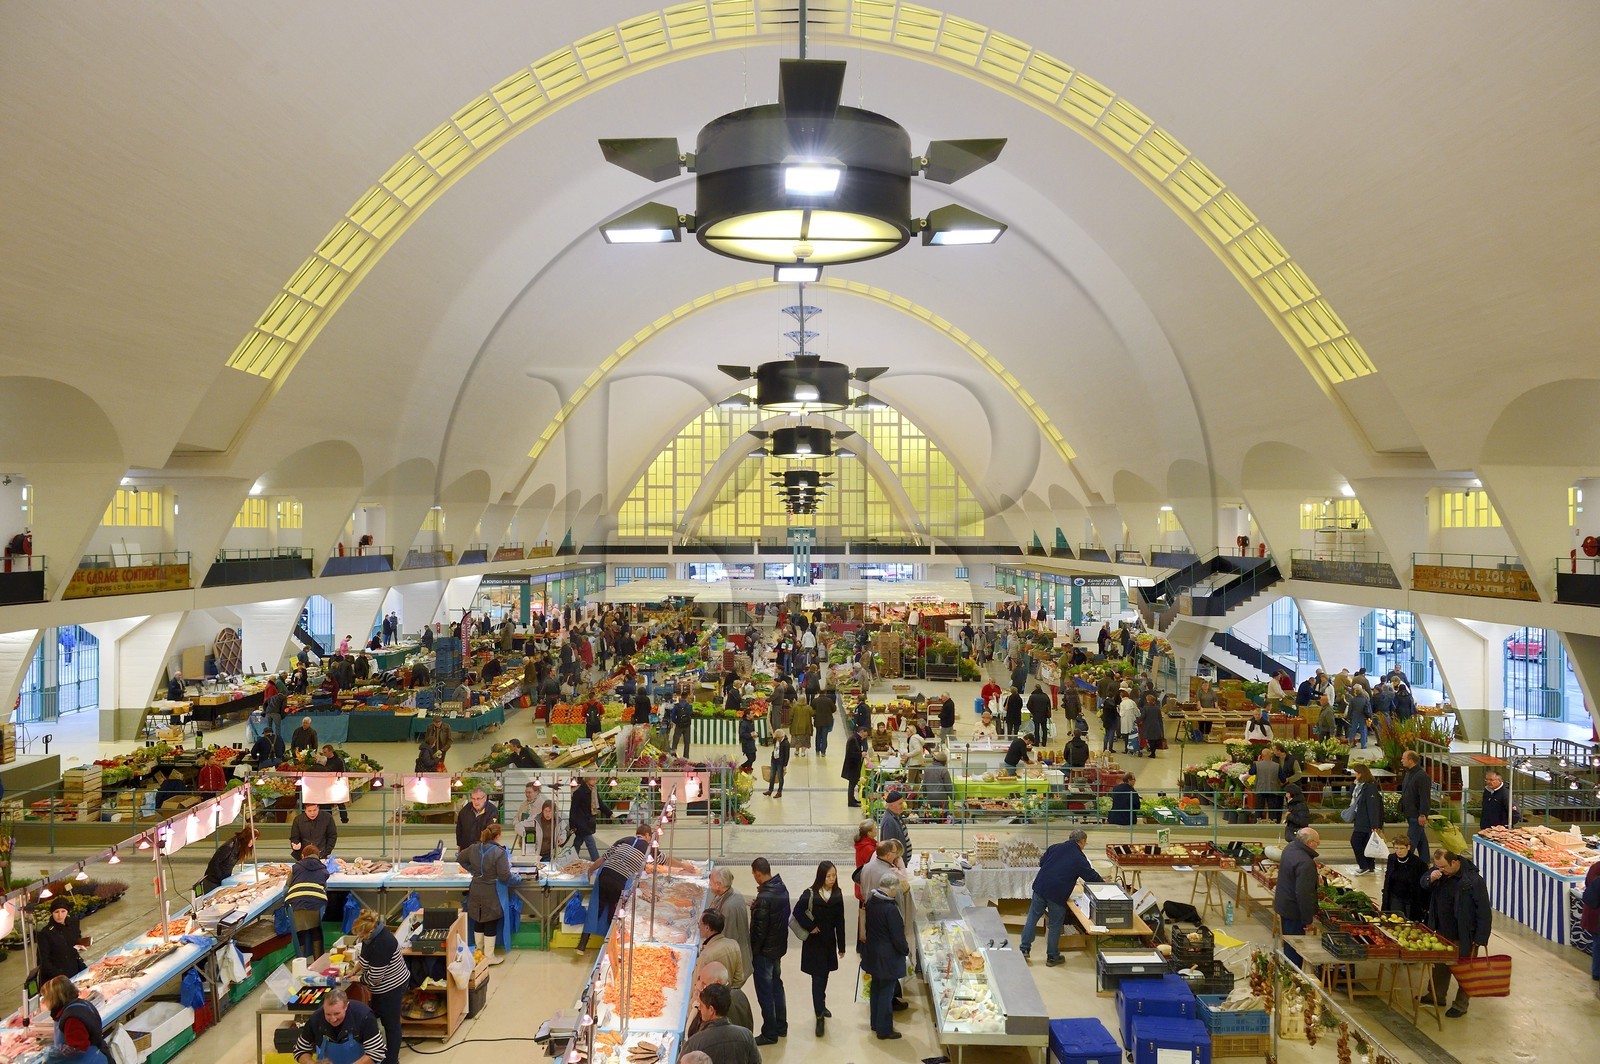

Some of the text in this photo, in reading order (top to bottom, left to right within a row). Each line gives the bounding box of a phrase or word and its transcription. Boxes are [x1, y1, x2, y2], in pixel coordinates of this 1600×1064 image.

[87, 570, 118, 585] GARAGE
[122, 567, 168, 582] CONTINENTAL
[1485, 571, 1515, 584] ZOLA
